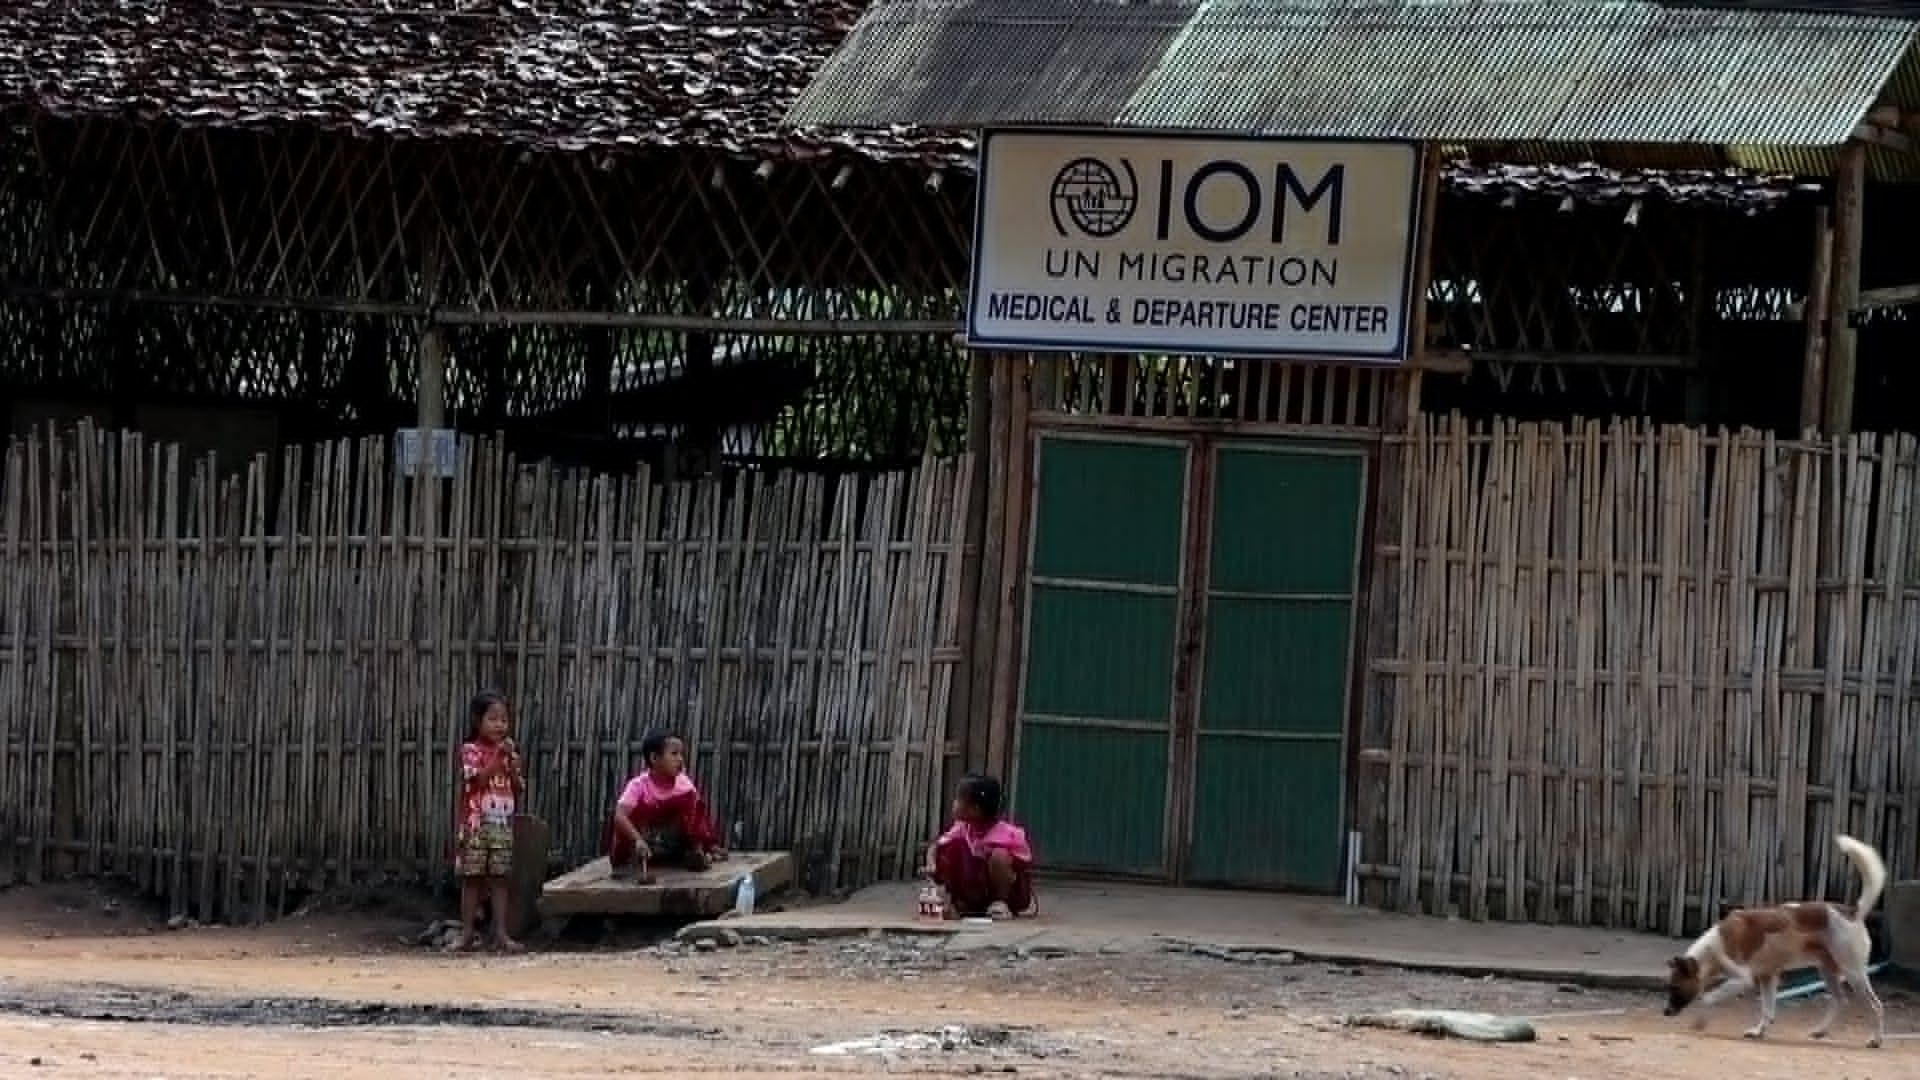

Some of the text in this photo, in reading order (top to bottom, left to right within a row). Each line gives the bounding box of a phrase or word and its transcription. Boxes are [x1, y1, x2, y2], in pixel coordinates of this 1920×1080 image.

[1157, 160, 1344, 244] IOM
[1045, 249, 1337, 287] UN MIGRATION
[988, 292, 1388, 333] MEDICAL & DEPARTURE CENTER
